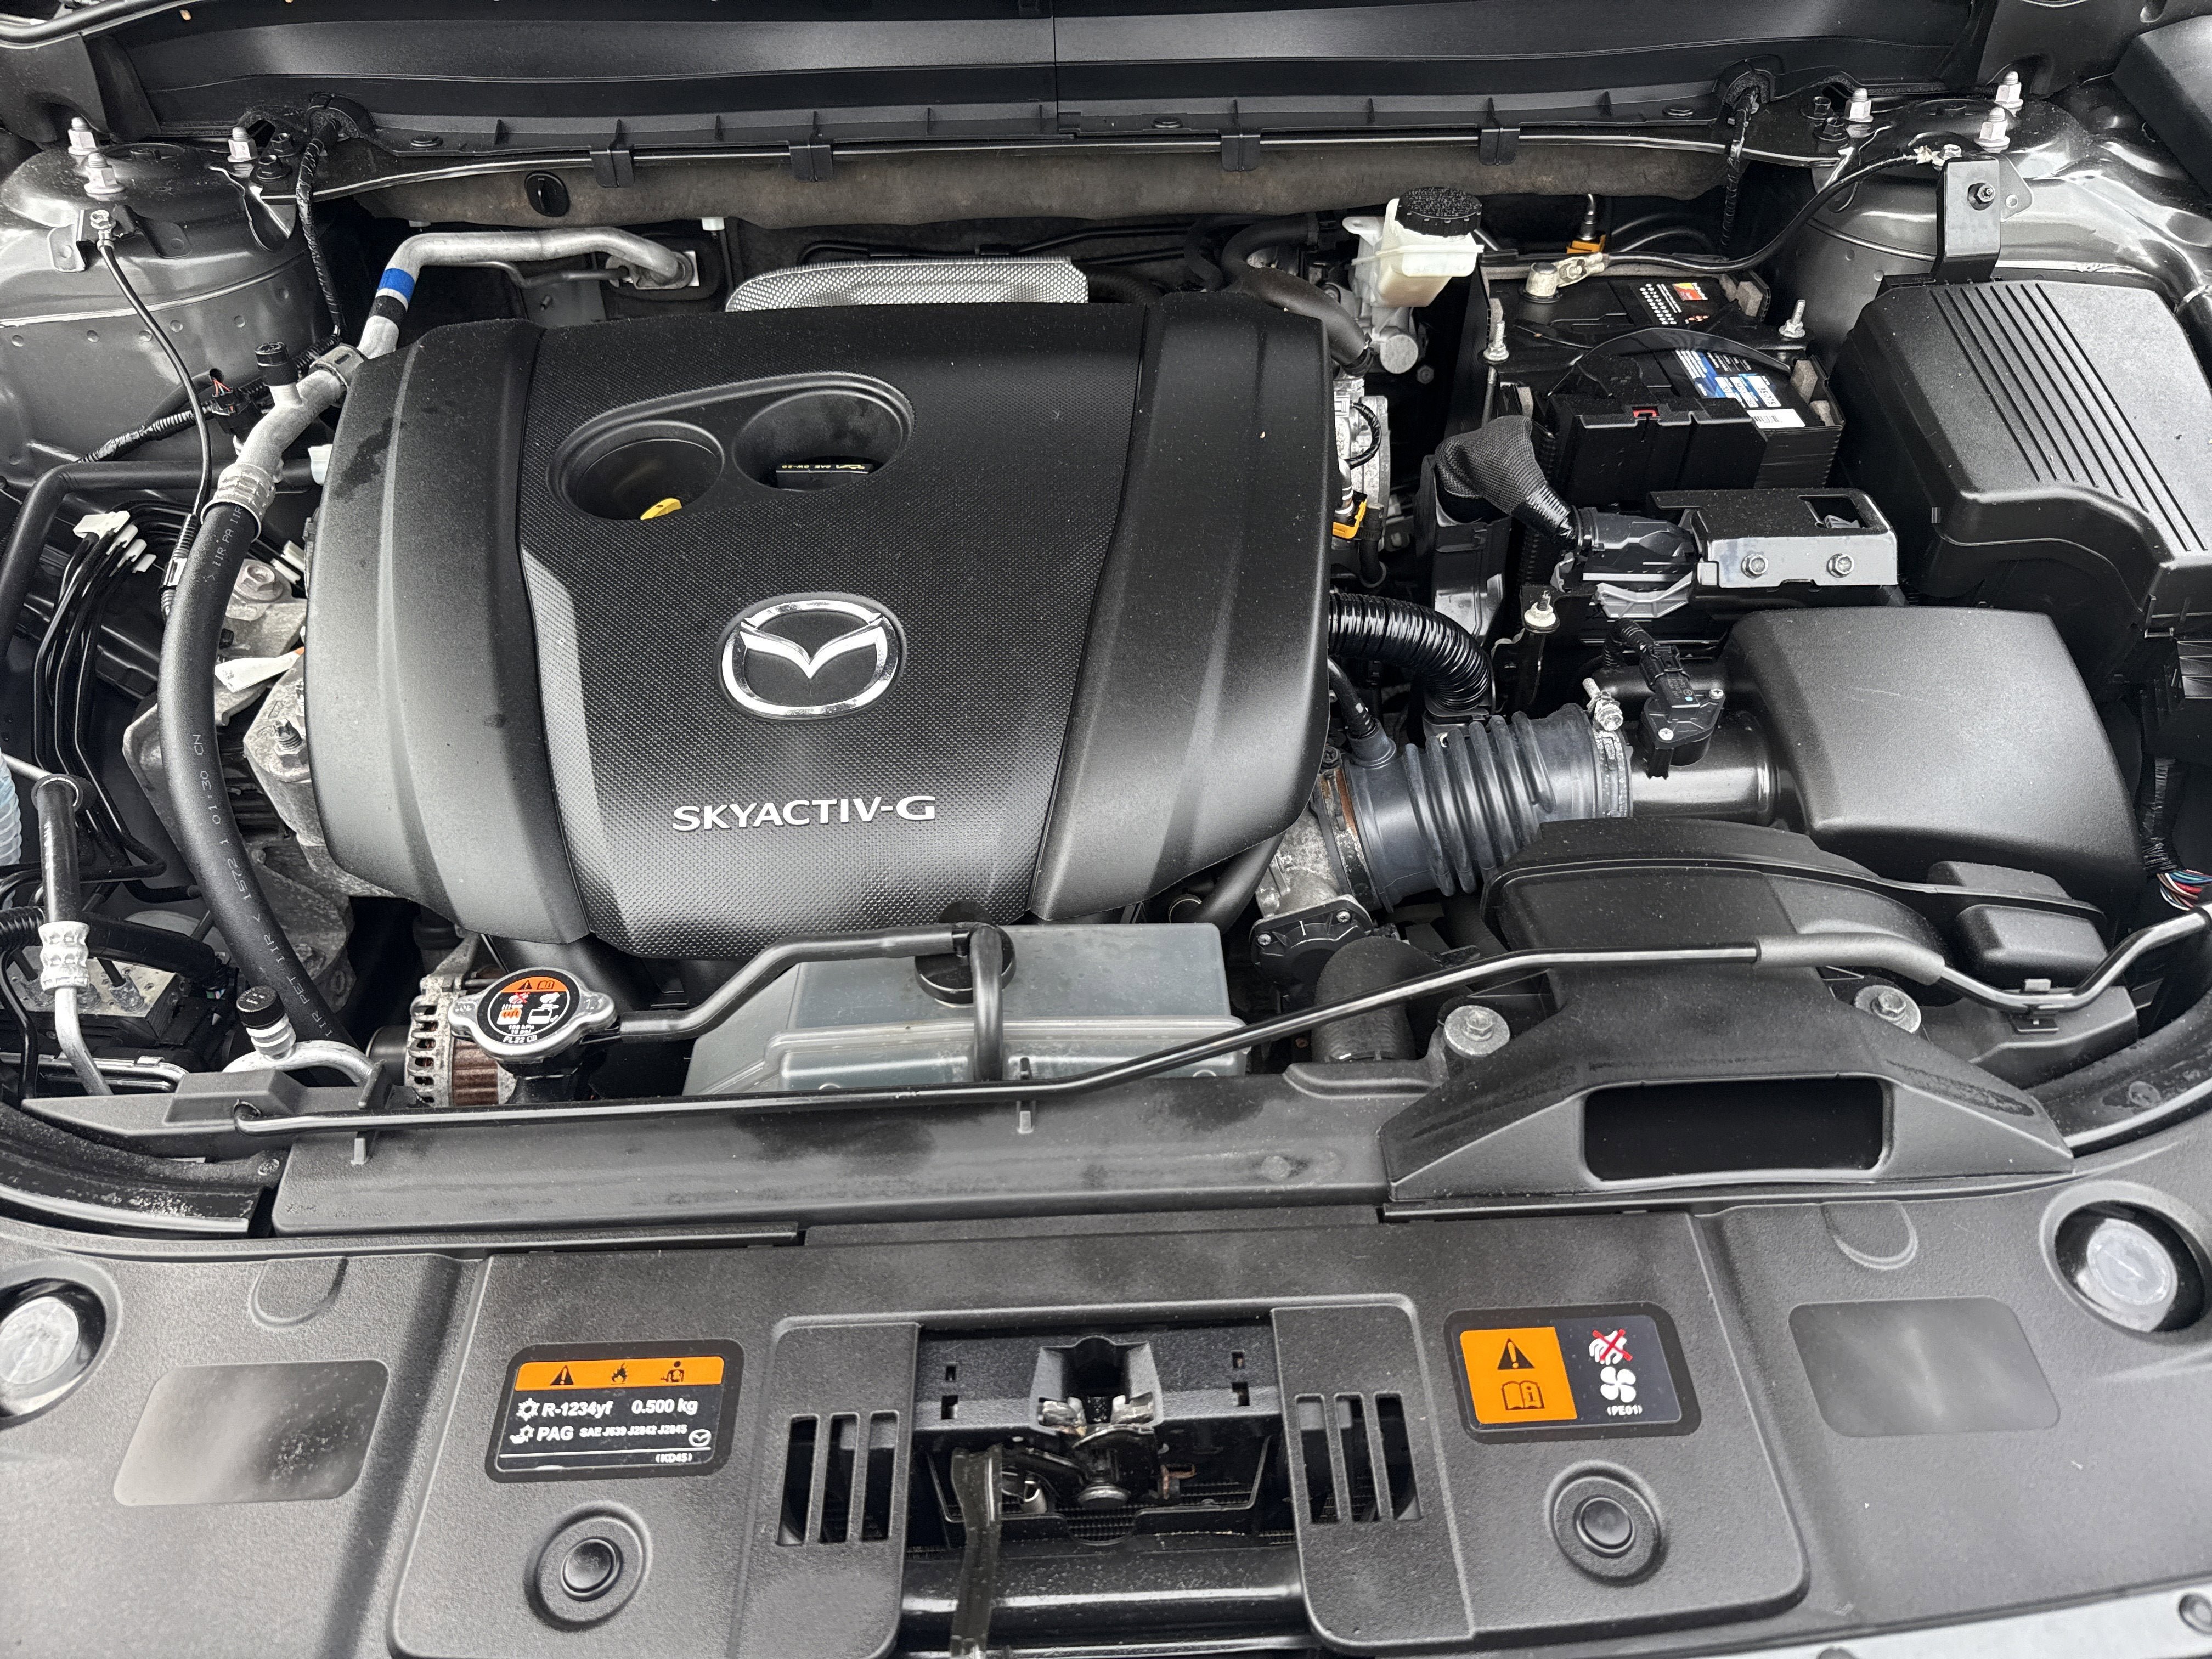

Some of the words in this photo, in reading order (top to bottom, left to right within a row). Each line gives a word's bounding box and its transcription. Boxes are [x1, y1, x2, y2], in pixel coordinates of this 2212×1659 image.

[222, 528, 234, 543] PA
[193, 734, 204, 756] CN
[672, 795, 936, 832] SKYACTIV-G
[287, 976, 311, 1005] PET
[542, 1401, 613, 1418] R-1234yf
[631, 1398, 674, 1414] 0.500
[677, 1398, 698, 1415] kg
[1607, 1404, 1643, 1415] (PE01)
[537, 1426, 574, 1441] PAG
[579, 1427, 602, 1438] SAE
[655, 1453, 693, 1463] (KD45)
